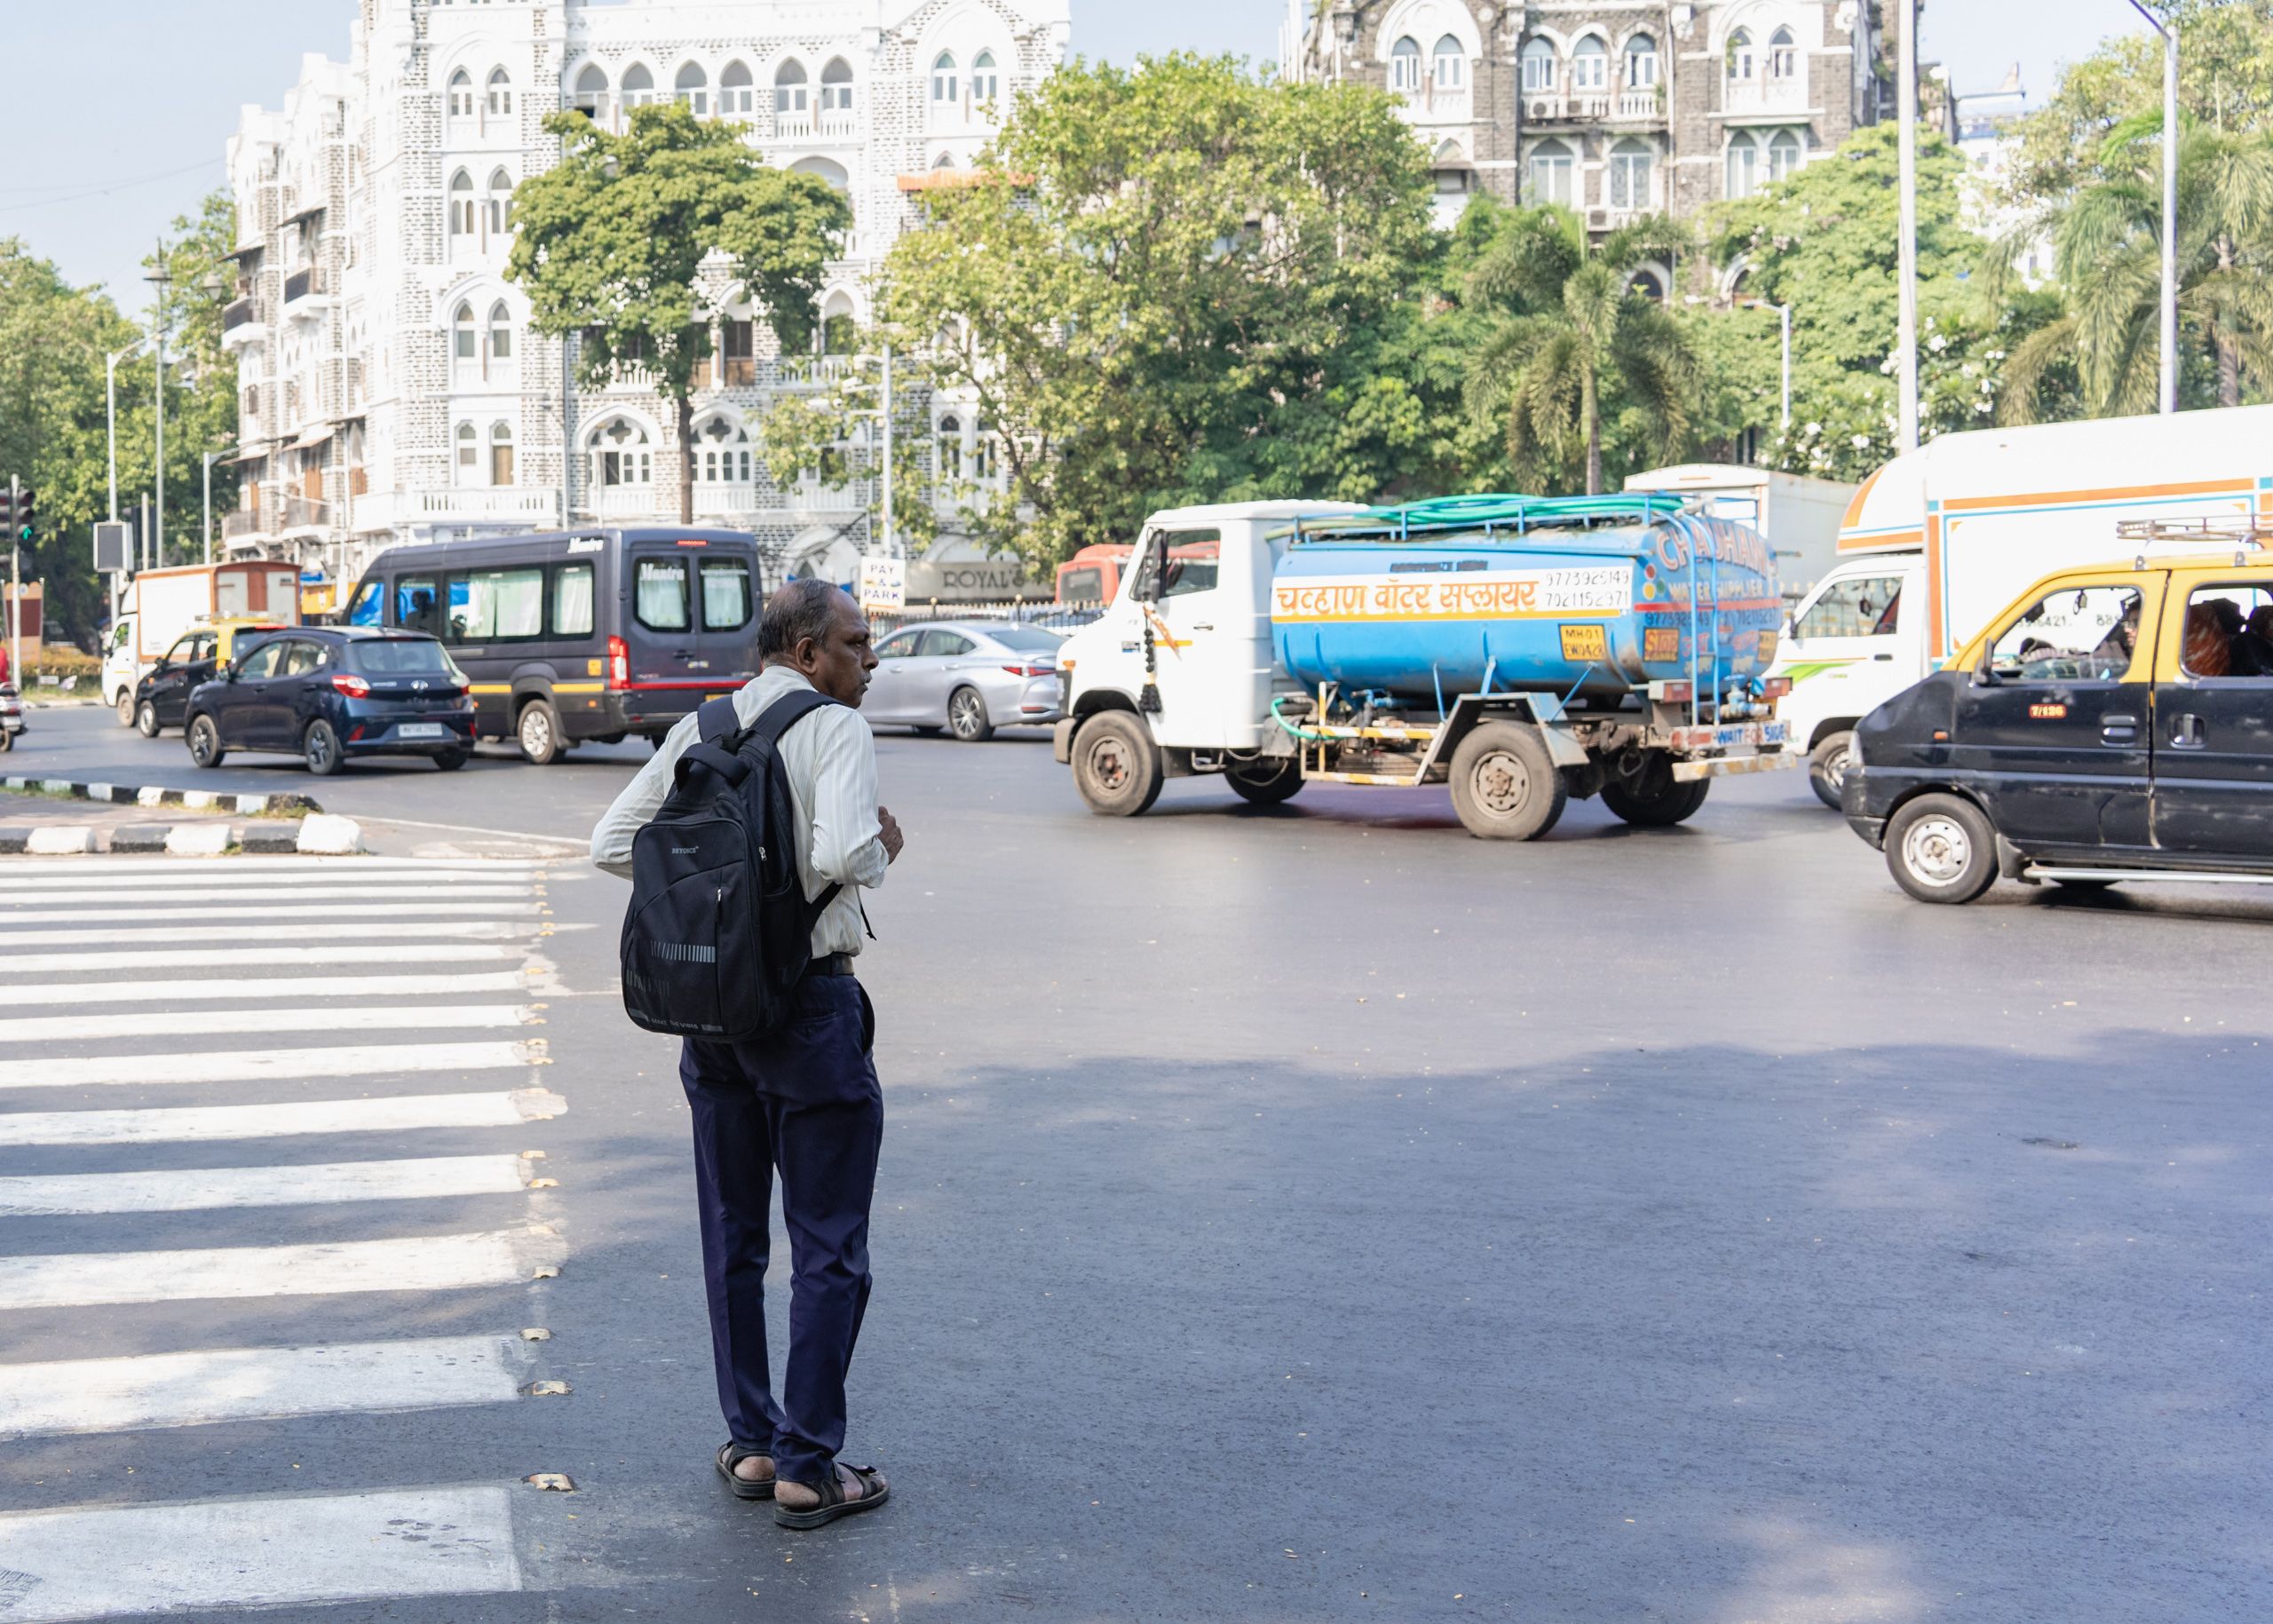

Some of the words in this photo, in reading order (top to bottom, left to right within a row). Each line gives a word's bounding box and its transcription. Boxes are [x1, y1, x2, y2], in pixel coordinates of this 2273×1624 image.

[639, 563, 685, 581] Mantra
[870, 564, 895, 574] PAY
[864, 589, 900, 600] PARK
[1375, 578, 1433, 610] वॉटर
[1440, 581, 1540, 611] सप्लायर
